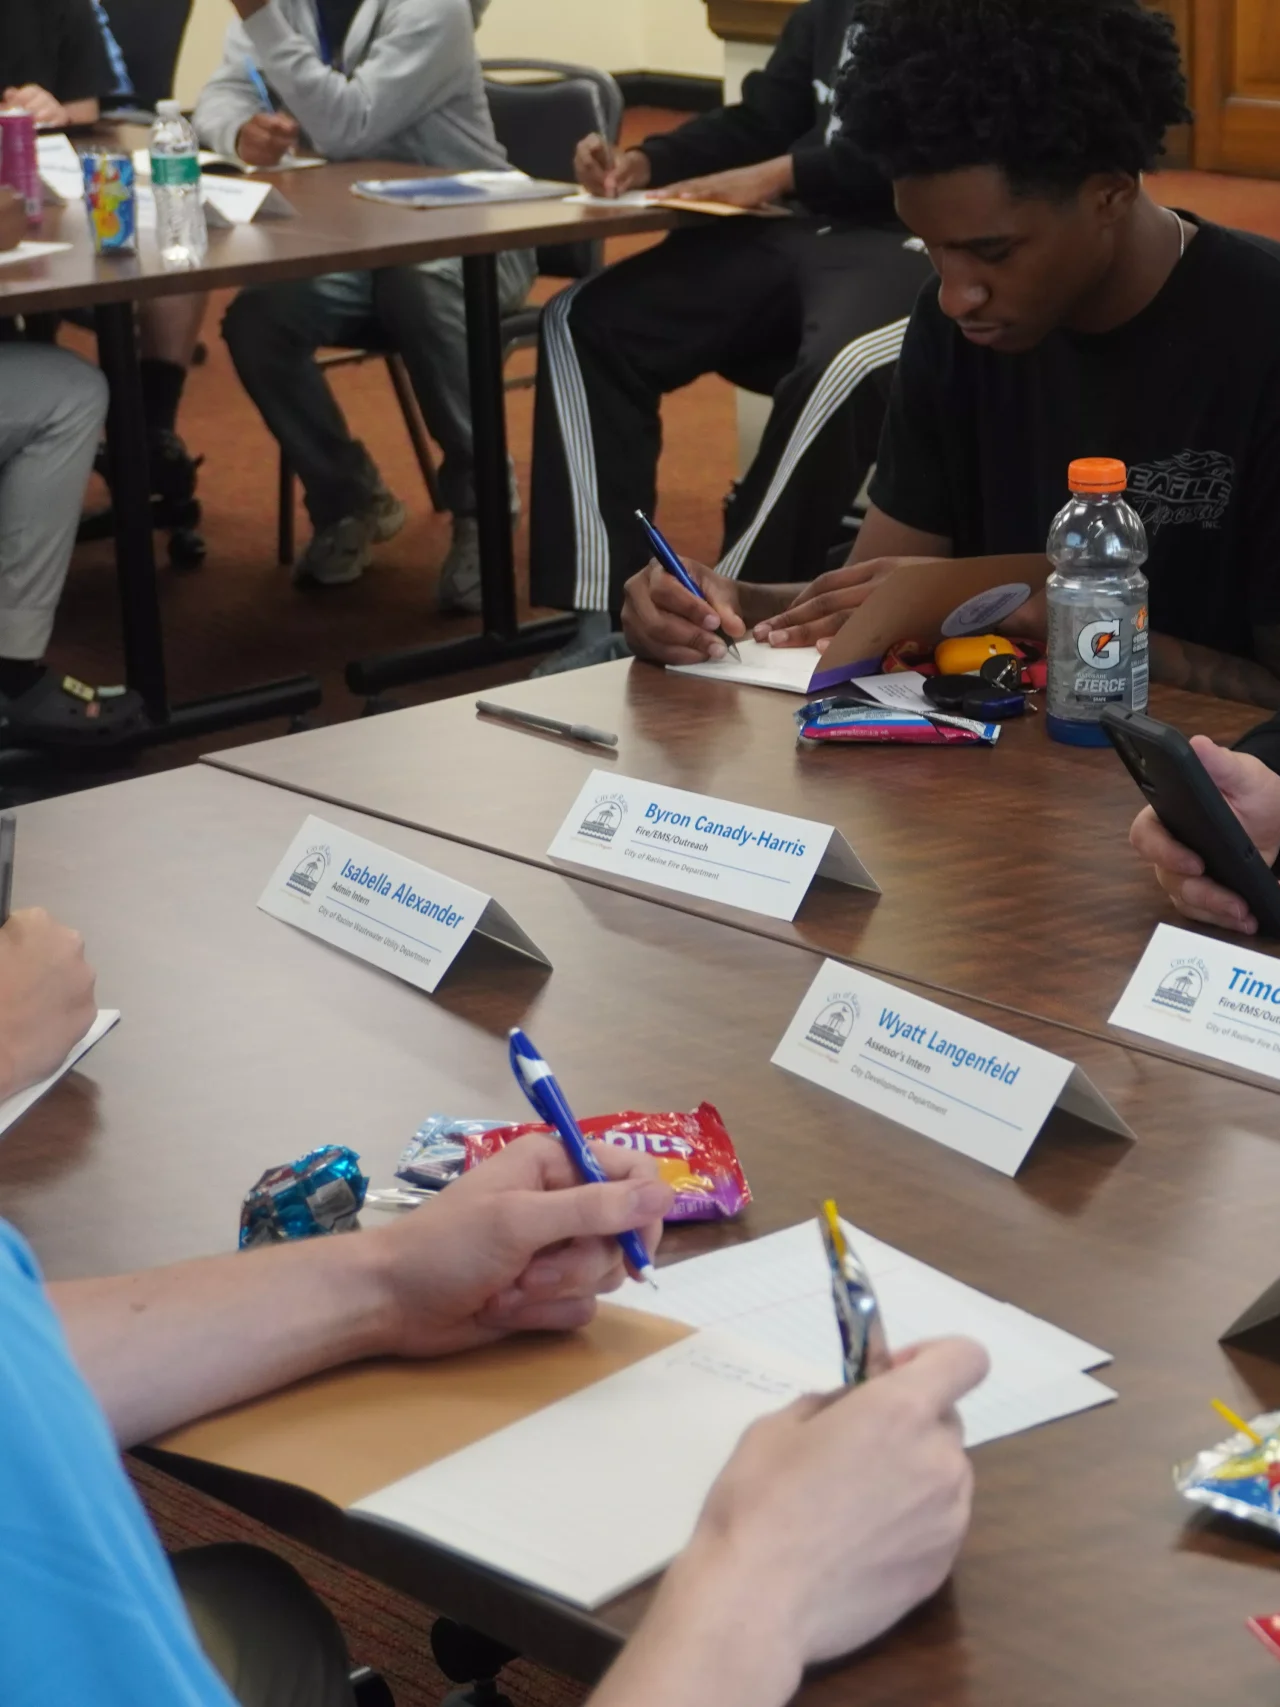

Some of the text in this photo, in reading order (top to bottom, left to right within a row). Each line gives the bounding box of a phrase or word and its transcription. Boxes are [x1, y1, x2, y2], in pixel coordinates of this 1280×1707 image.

[1126, 466, 1232, 503] EAGLE
[1077, 618, 1122, 670] G
[1074, 678, 1126, 693] FIERCE
[635, 825, 709, 853] Fire/EMS/Outreach
[644, 803, 806, 857] Byron Canady-Harris
[624, 848, 720, 881] City of Racine Fire Department
[331, 881, 370, 906] Admin Intern
[340, 858, 392, 897] Isabella
[391, 882, 464, 929] Alexander
[318, 905, 431, 966] City of Racine Wastewater Utility Department
[878, 1007, 1021, 1086] Wyatt Langenfeld
[1206, 1021, 1219, 1035] City
[1221, 1026, 1231, 1036] of
[1231, 1030, 1256, 1044] Racine
[1257, 1036, 1271, 1050] Fire
[865, 1036, 905, 1063] Assessor's
[905, 1055, 931, 1074] Intern
[850, 1064, 948, 1116] City Development Department
